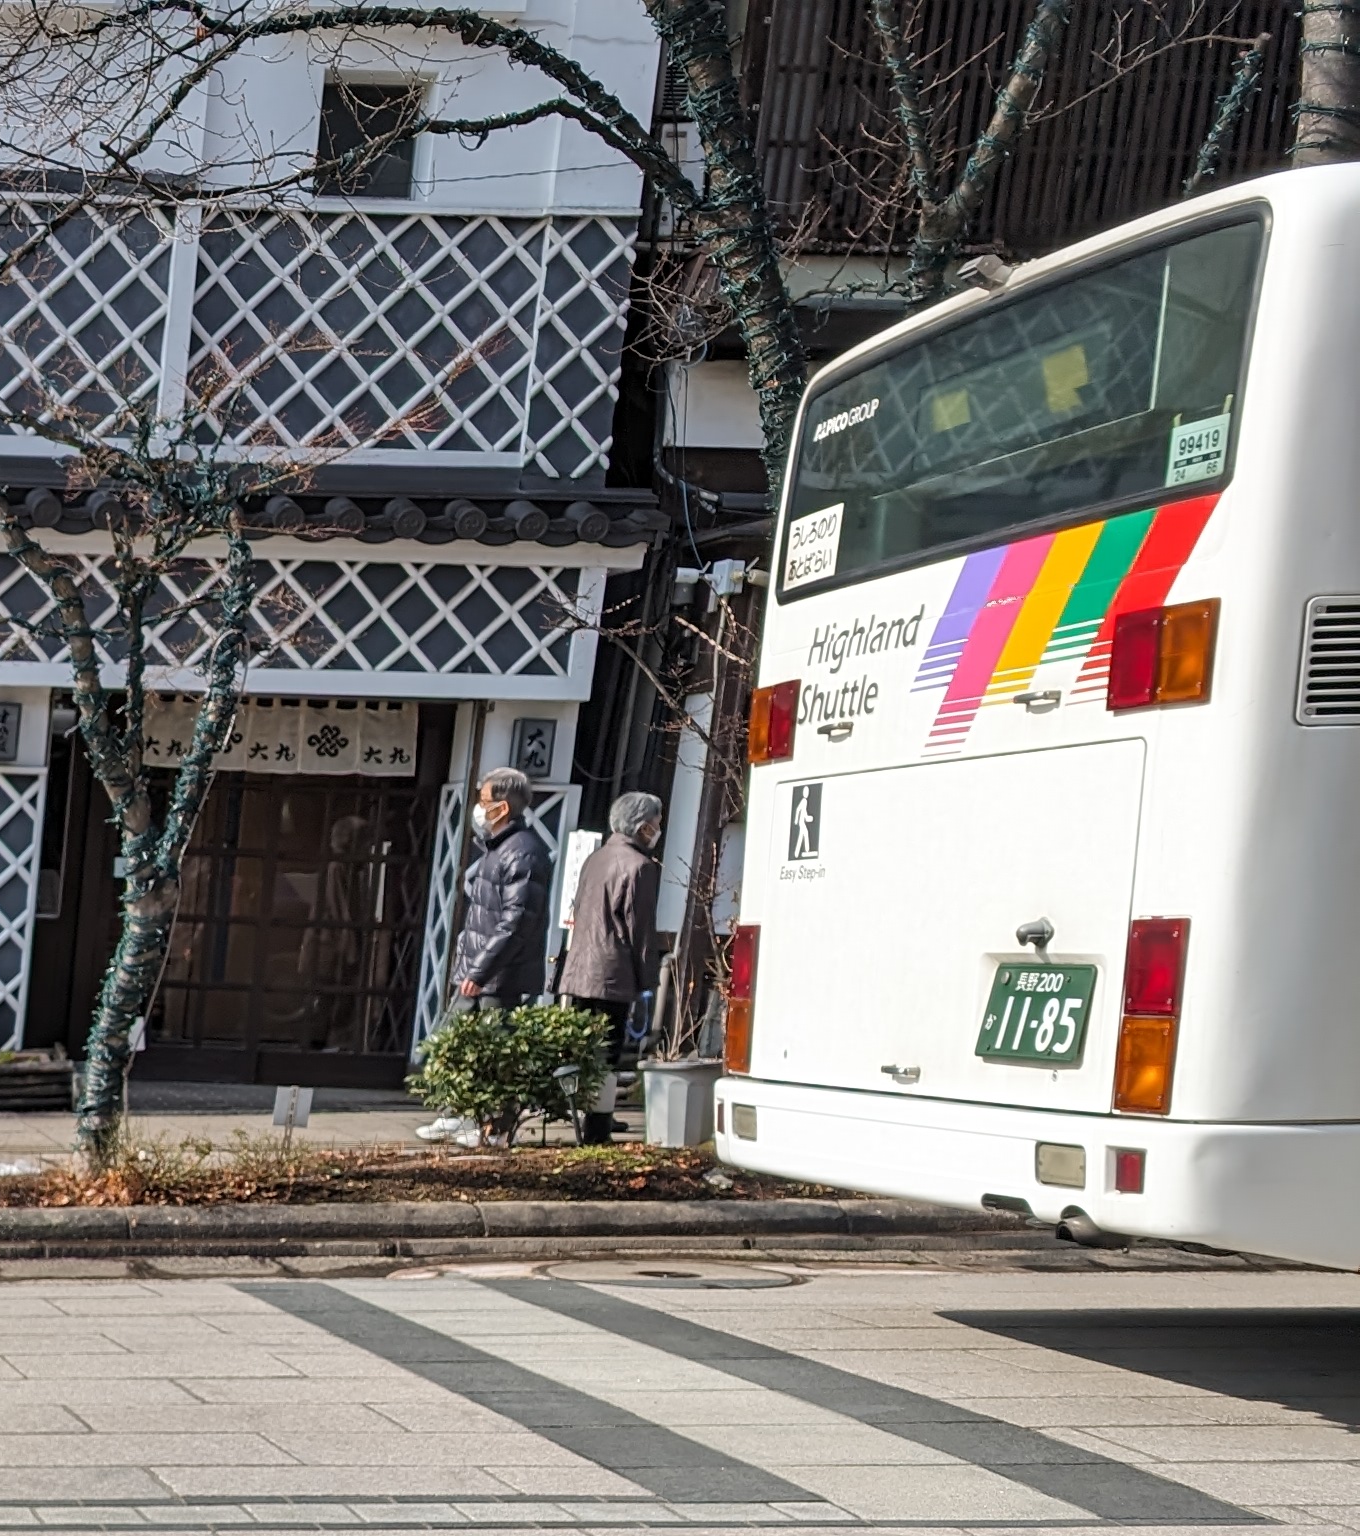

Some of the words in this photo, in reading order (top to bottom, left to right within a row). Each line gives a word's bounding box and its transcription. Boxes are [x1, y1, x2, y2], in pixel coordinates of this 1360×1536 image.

[848, 398, 879, 427] GROUP
[1178, 429, 1220, 456] 99419
[1174, 468, 1186, 482] 24
[793, 513, 837, 550] うしろのり
[788, 548, 832, 581] あとばらい
[807, 604, 925, 674] Highland
[797, 674, 879, 725] Shuttle
[780, 866, 797, 883] Easy
[798, 864, 825, 882] Step-in
[995, 996, 1083, 1053] 11-85
